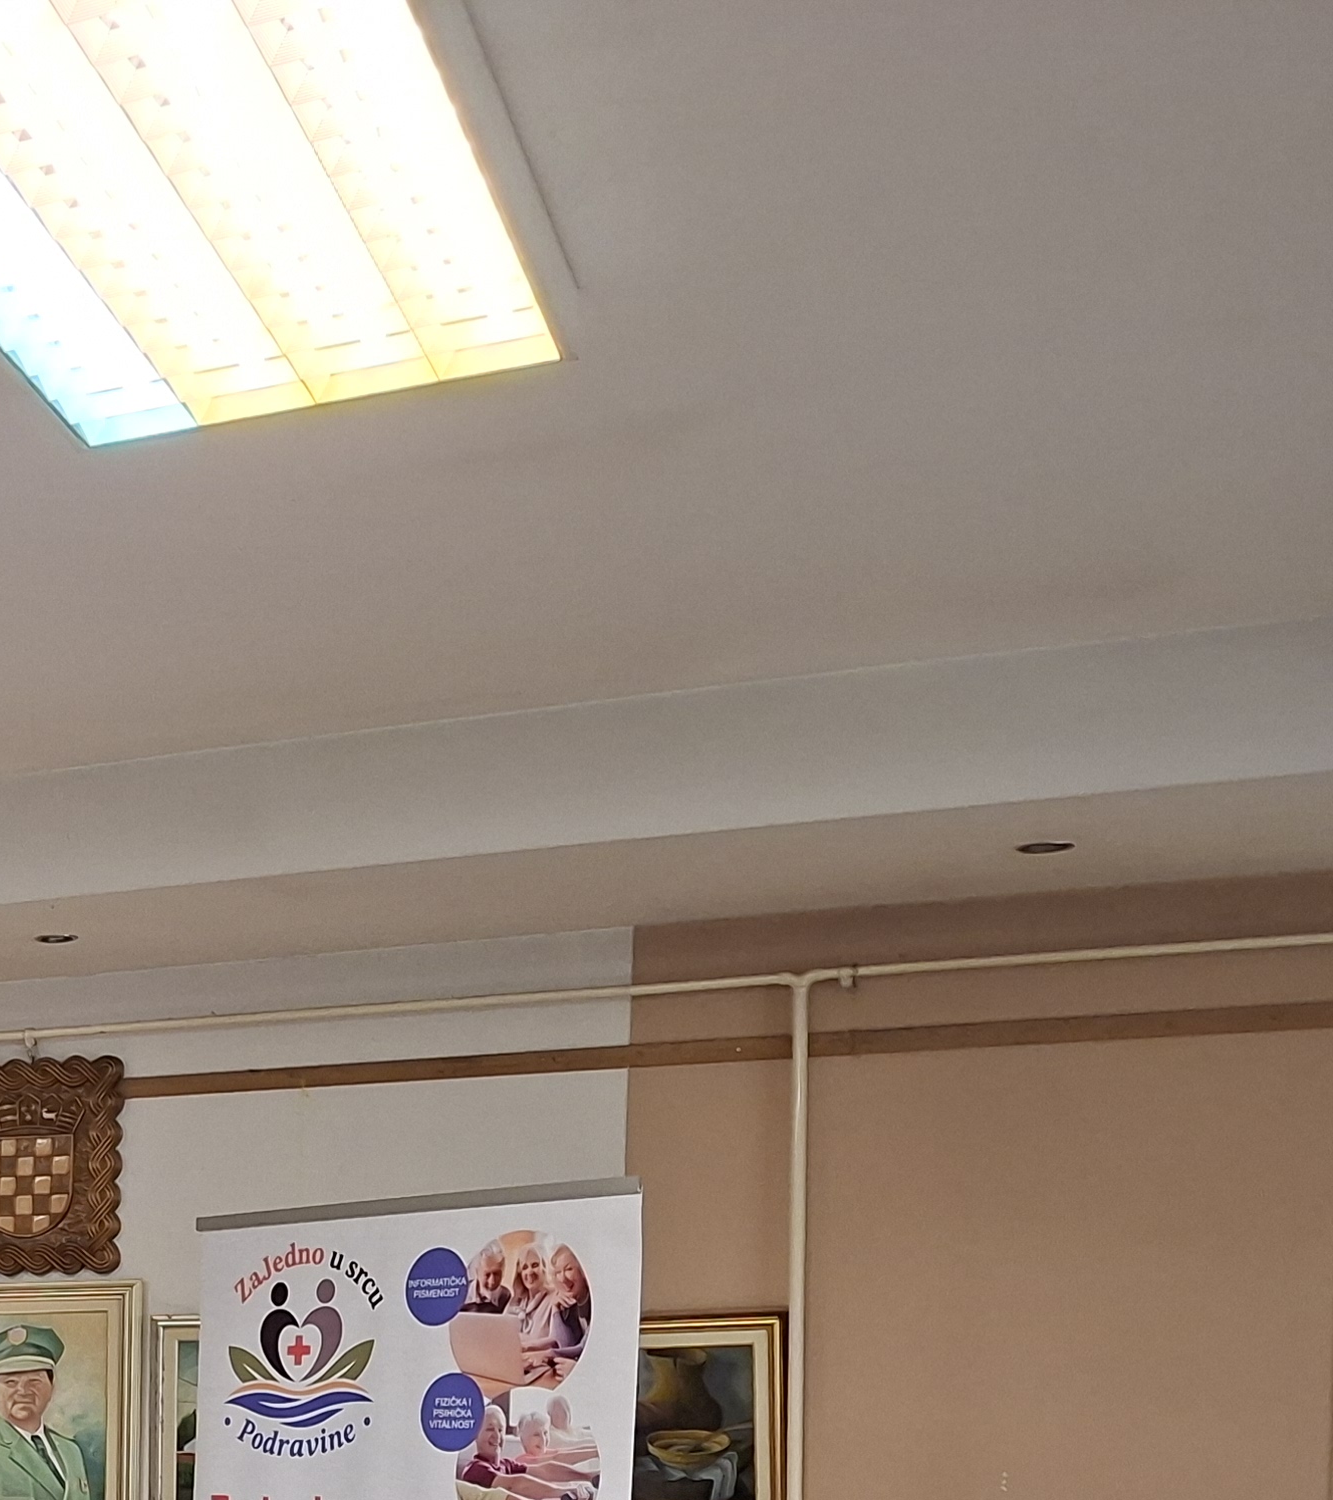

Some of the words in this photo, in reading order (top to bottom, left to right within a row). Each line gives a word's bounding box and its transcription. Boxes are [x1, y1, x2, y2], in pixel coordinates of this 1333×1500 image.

[234, 1242, 325, 1304] ZaJedno
[330, 1250, 344, 1270] u
[345, 1257, 384, 1310] srcu
[408, 1276, 467, 1288] INFORMATIČKA
[413, 1288, 460, 1298] PISMENOST
[434, 1396, 467, 1407] FIZIČKA
[433, 1407, 472, 1418] PSIHIČKA
[429, 1419, 475, 1429] VITALNOST
[237, 1418, 356, 1458] Podravine
